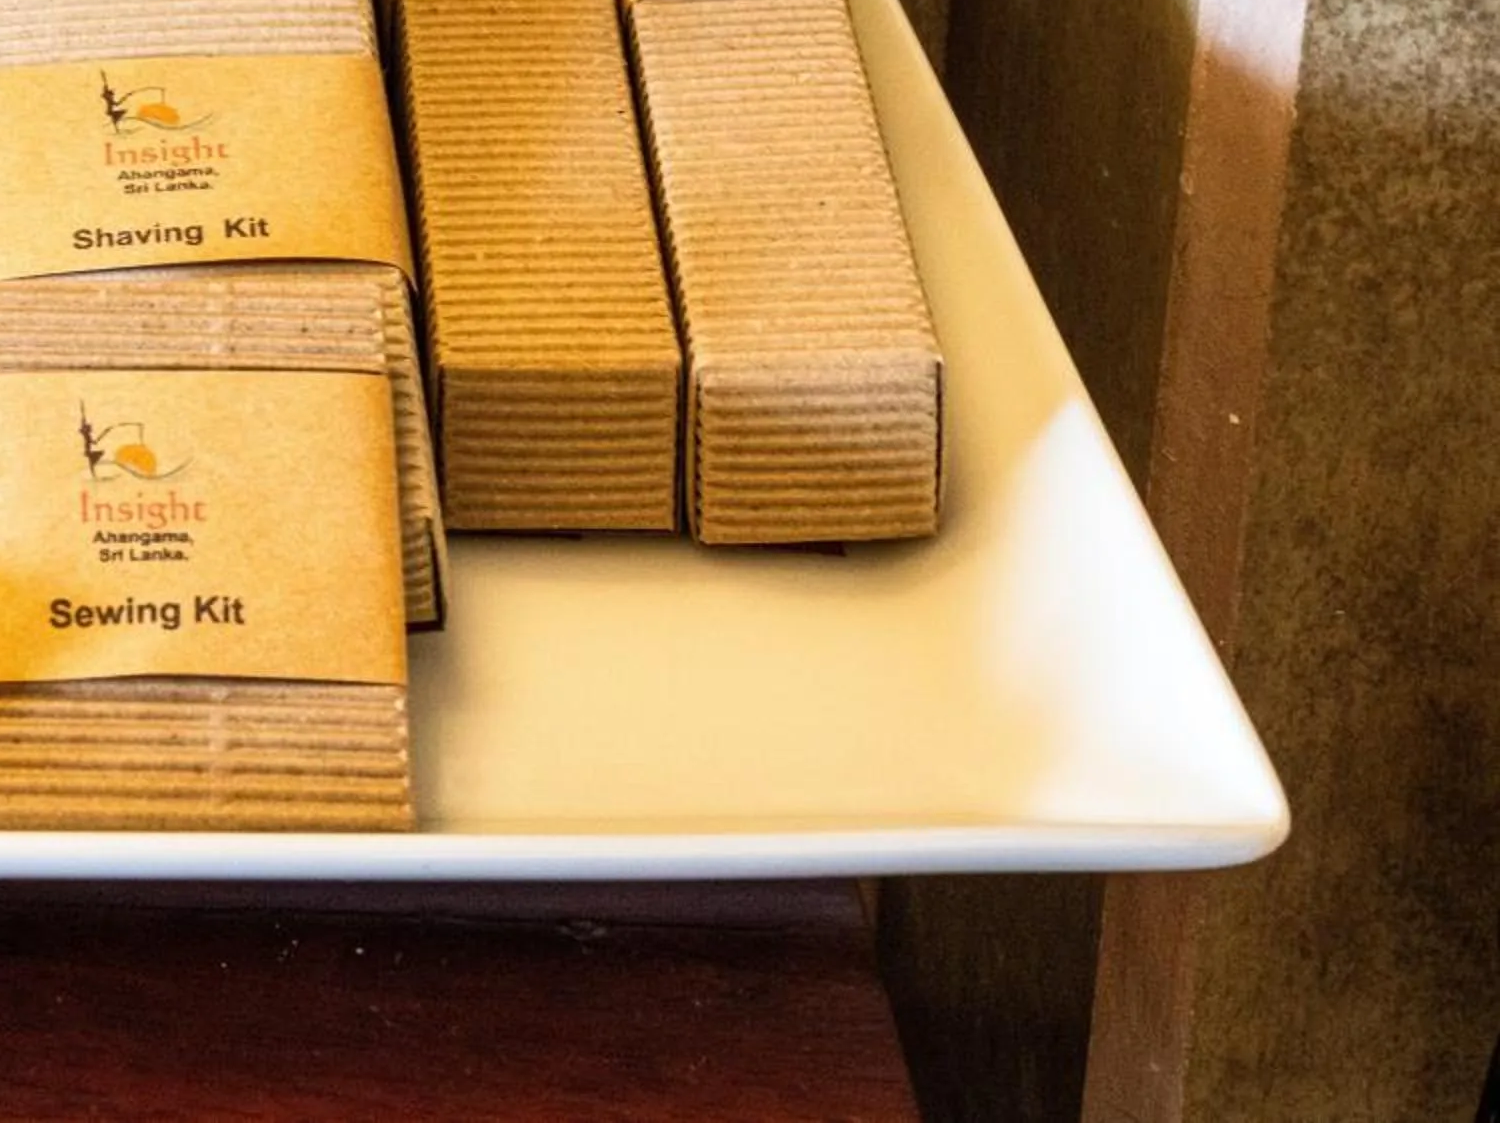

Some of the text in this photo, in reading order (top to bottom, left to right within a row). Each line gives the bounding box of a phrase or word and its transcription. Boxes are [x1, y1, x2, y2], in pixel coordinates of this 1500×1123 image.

[103, 136, 229, 167] Insight
[123, 180, 214, 194] Sri Lanka.
[72, 217, 270, 250] Shaving Kit
[80, 489, 208, 530] Insight
[93, 530, 194, 546] Ahangama,
[99, 548, 189, 562] Sri Lanka.
[49, 595, 245, 630] Sewing Kit
